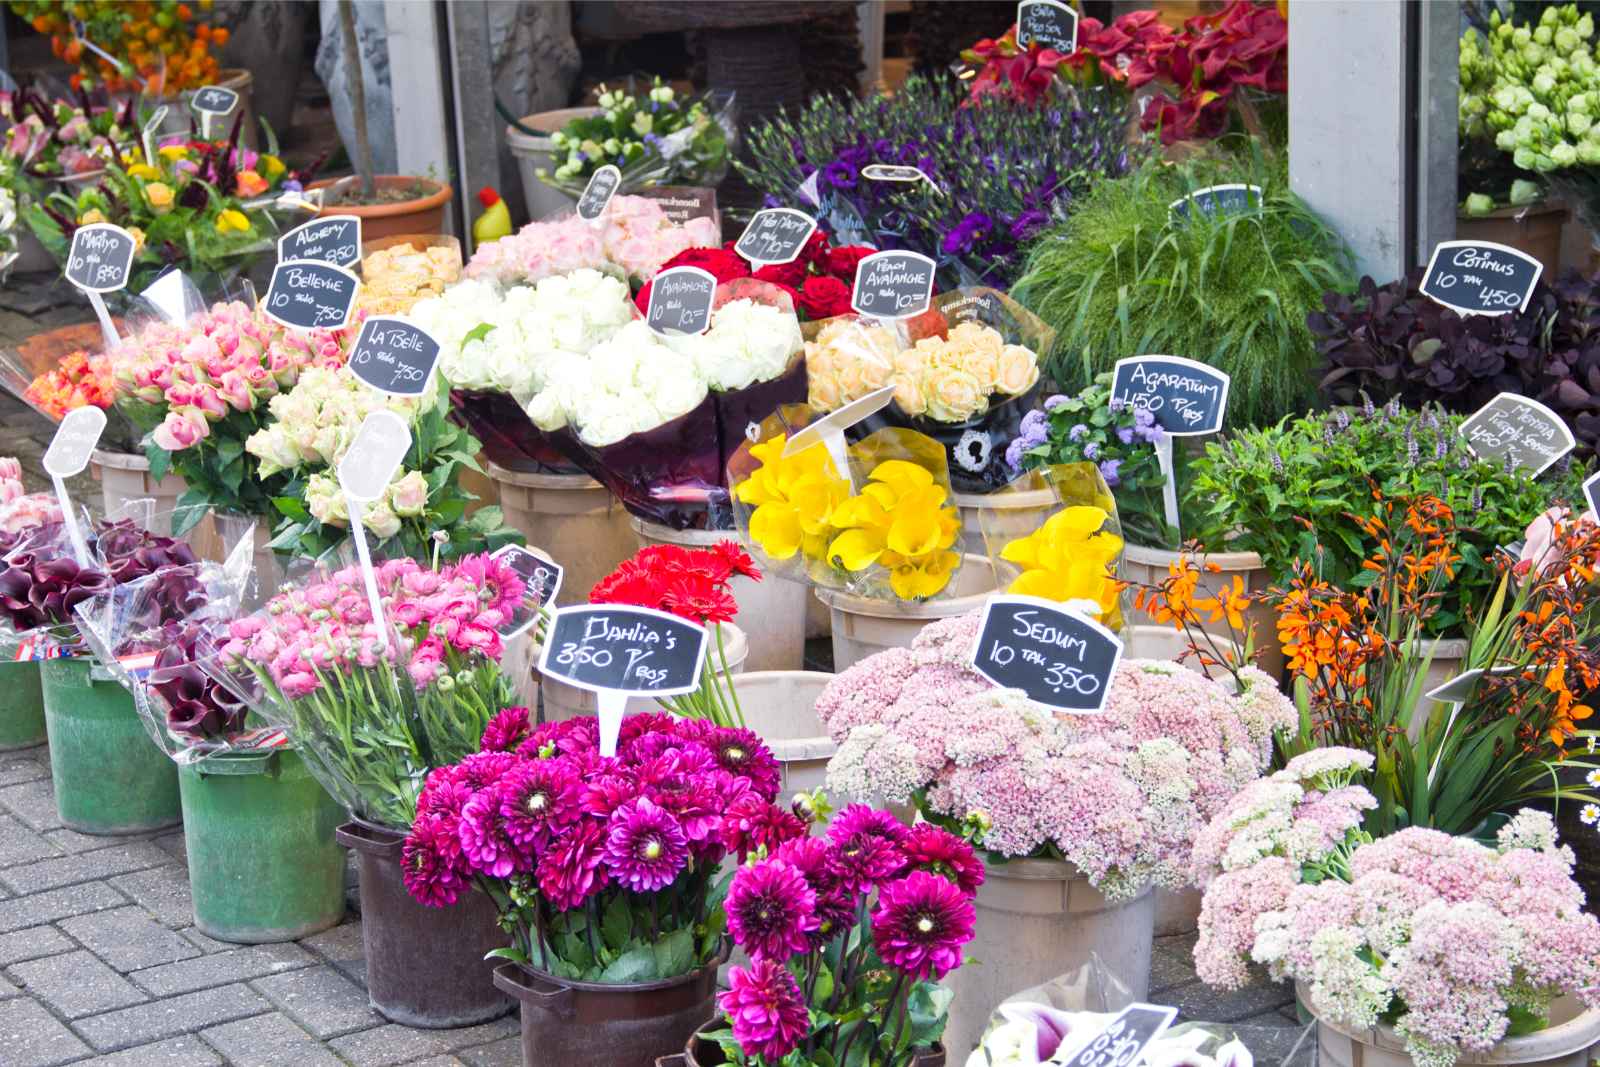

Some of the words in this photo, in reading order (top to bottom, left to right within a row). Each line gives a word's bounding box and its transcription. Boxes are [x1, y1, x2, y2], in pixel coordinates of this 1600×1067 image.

[741, 232, 757, 246] 10
[70, 255, 85, 271] 10
[1435, 271, 1458, 289] 10
[271, 291, 290, 308] 10
[859, 291, 875, 307] 10
[651, 304, 664, 322] 10
[354, 347, 371, 364] 10
[989, 639, 1016, 665] 10
